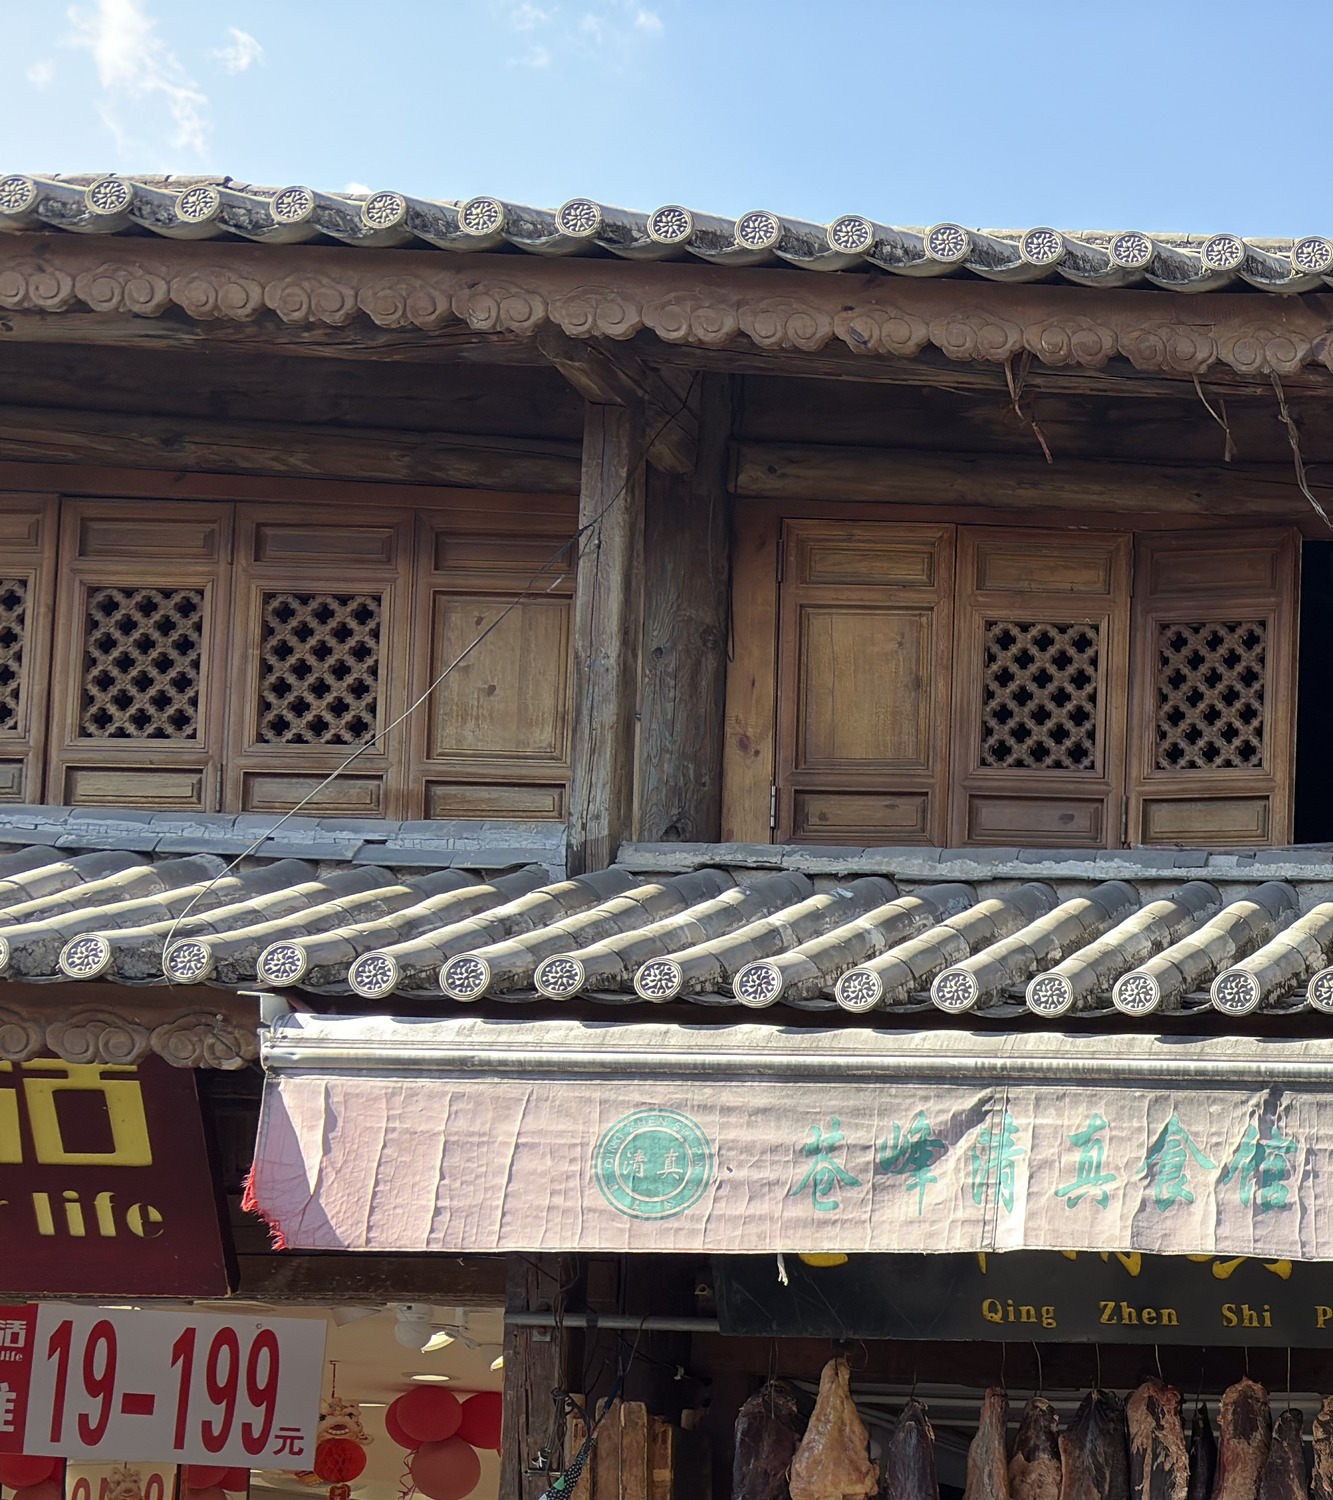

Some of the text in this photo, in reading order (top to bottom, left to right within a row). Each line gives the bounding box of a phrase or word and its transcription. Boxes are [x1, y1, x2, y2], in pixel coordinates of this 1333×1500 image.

[622, 1149, 684, 1180] 清真
[32, 1190, 164, 1237] life
[982, 1299, 1055, 1328] Qing
[1100, 1302, 1179, 1326] Zhen
[1222, 1304, 1273, 1328] Shi
